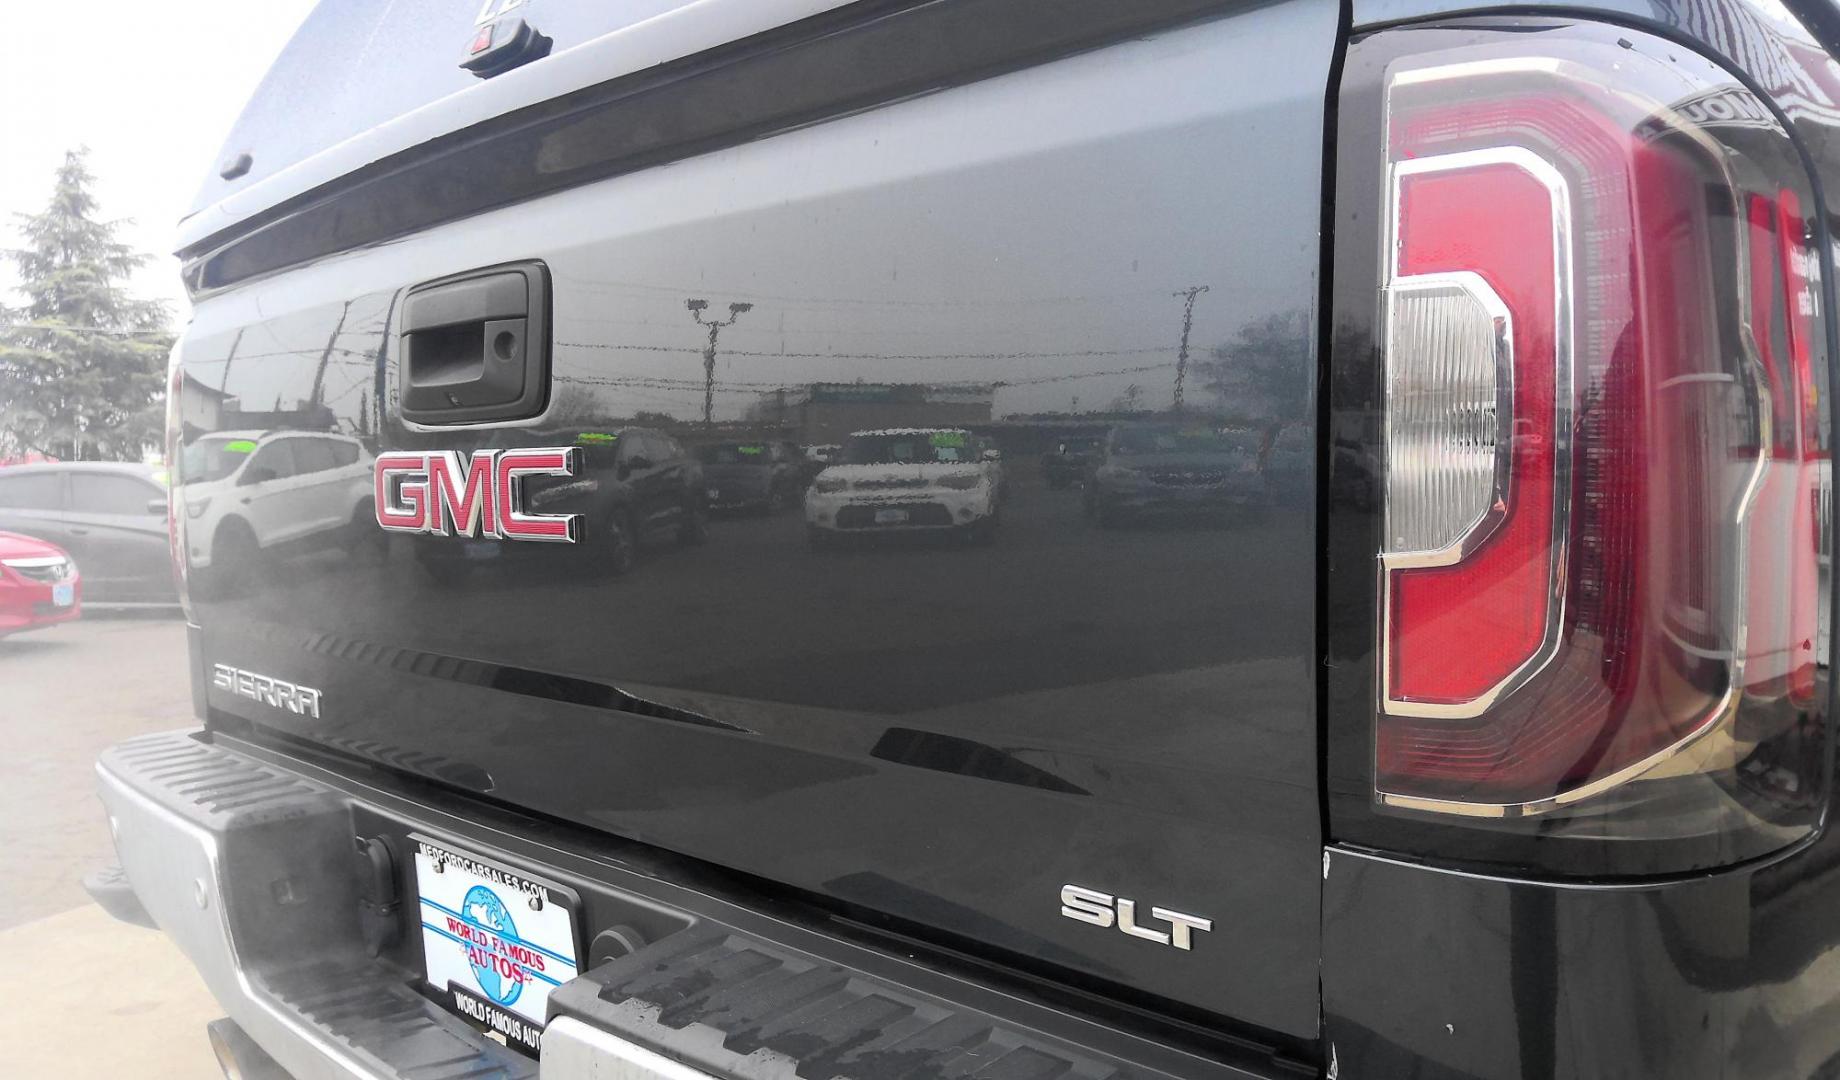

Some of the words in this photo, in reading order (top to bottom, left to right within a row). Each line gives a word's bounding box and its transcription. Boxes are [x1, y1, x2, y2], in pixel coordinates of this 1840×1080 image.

[374, 447, 585, 543] GMC
[213, 663, 321, 719] SIERRA
[419, 843, 549, 902] MEDFORDCARSALES.COM
[446, 916, 488, 947] WORLD
[492, 936, 545, 971] FAMOUS
[1060, 884, 1213, 950] SLT
[469, 944, 524, 984] AUTOS
[455, 991, 485, 1022] WORLD
[485, 1006, 522, 1041] FAMOUS
